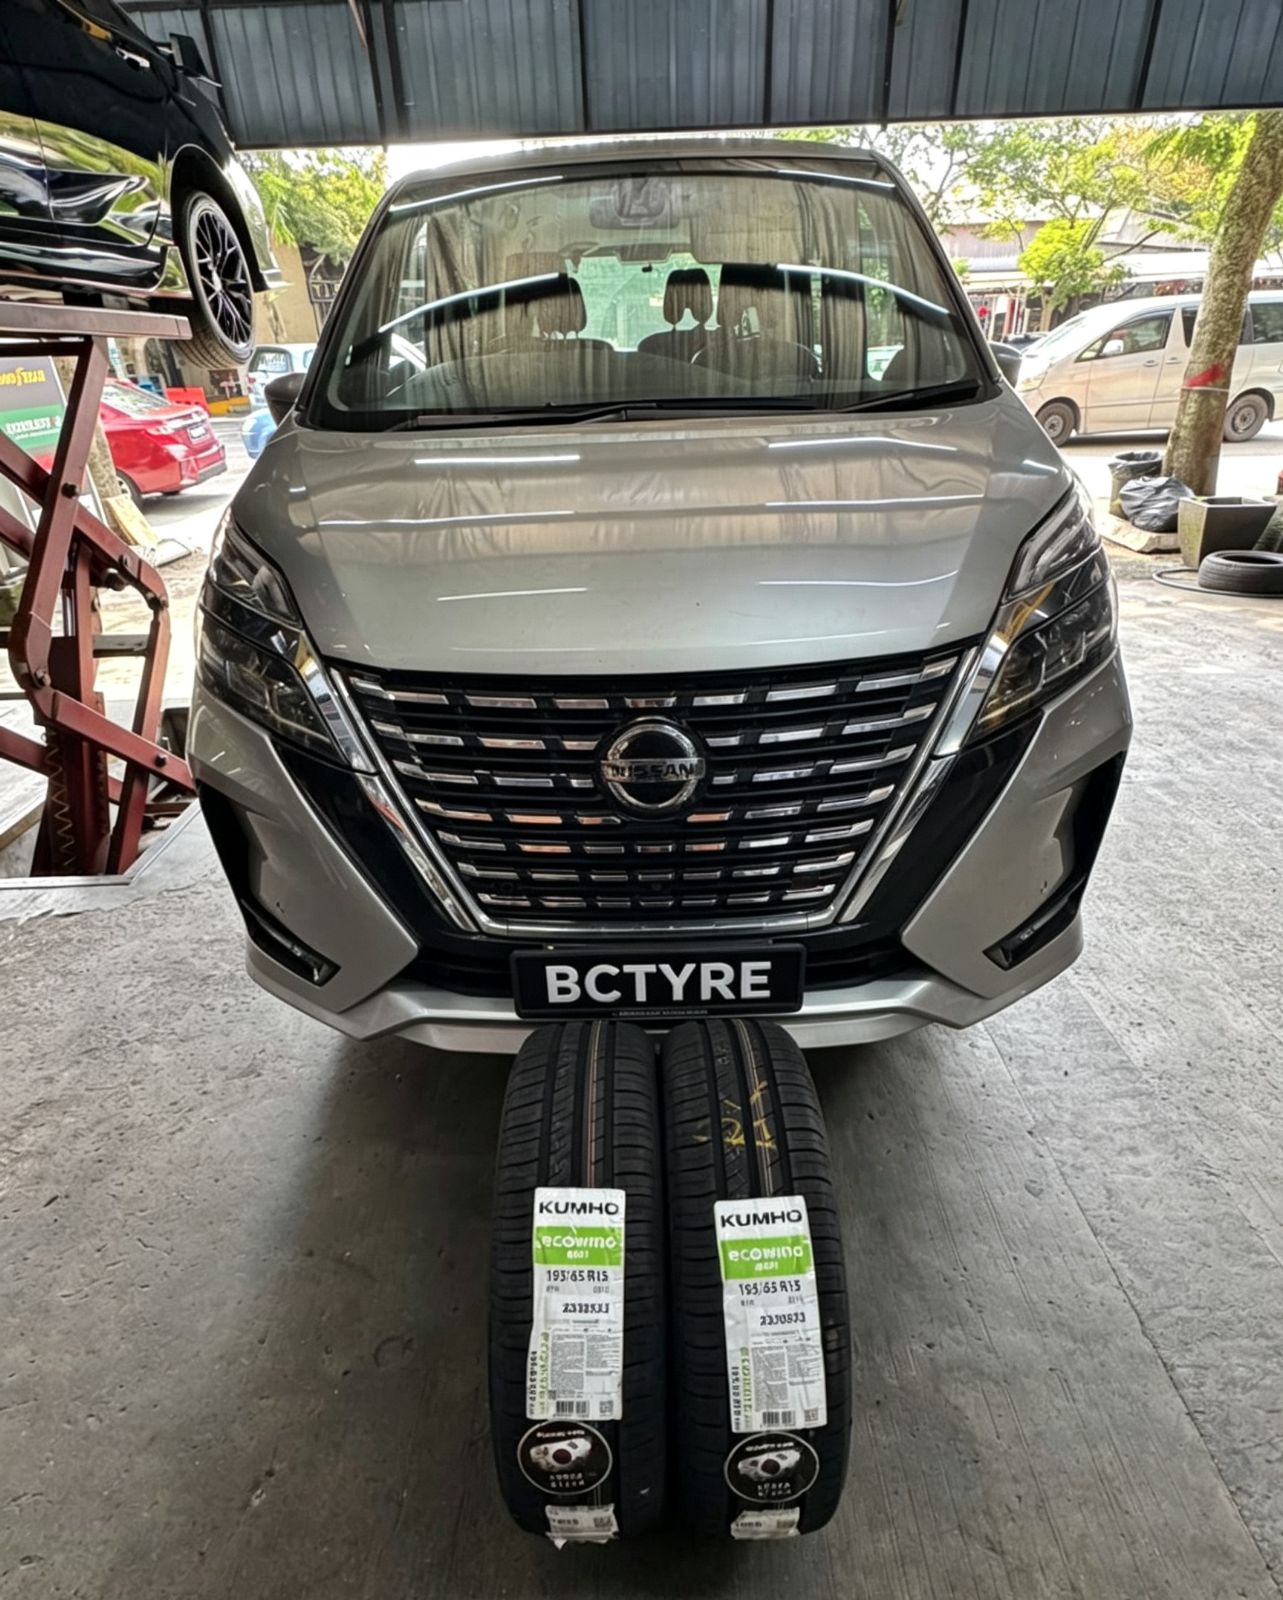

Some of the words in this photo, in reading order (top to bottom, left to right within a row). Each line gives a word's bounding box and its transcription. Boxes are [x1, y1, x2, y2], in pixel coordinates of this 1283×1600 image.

[607, 763, 694, 779] NISSAN
[545, 960, 772, 1004] BCTYRE
[539, 1201, 619, 1215] KUMHO
[720, 1209, 802, 1228] KUMHO
